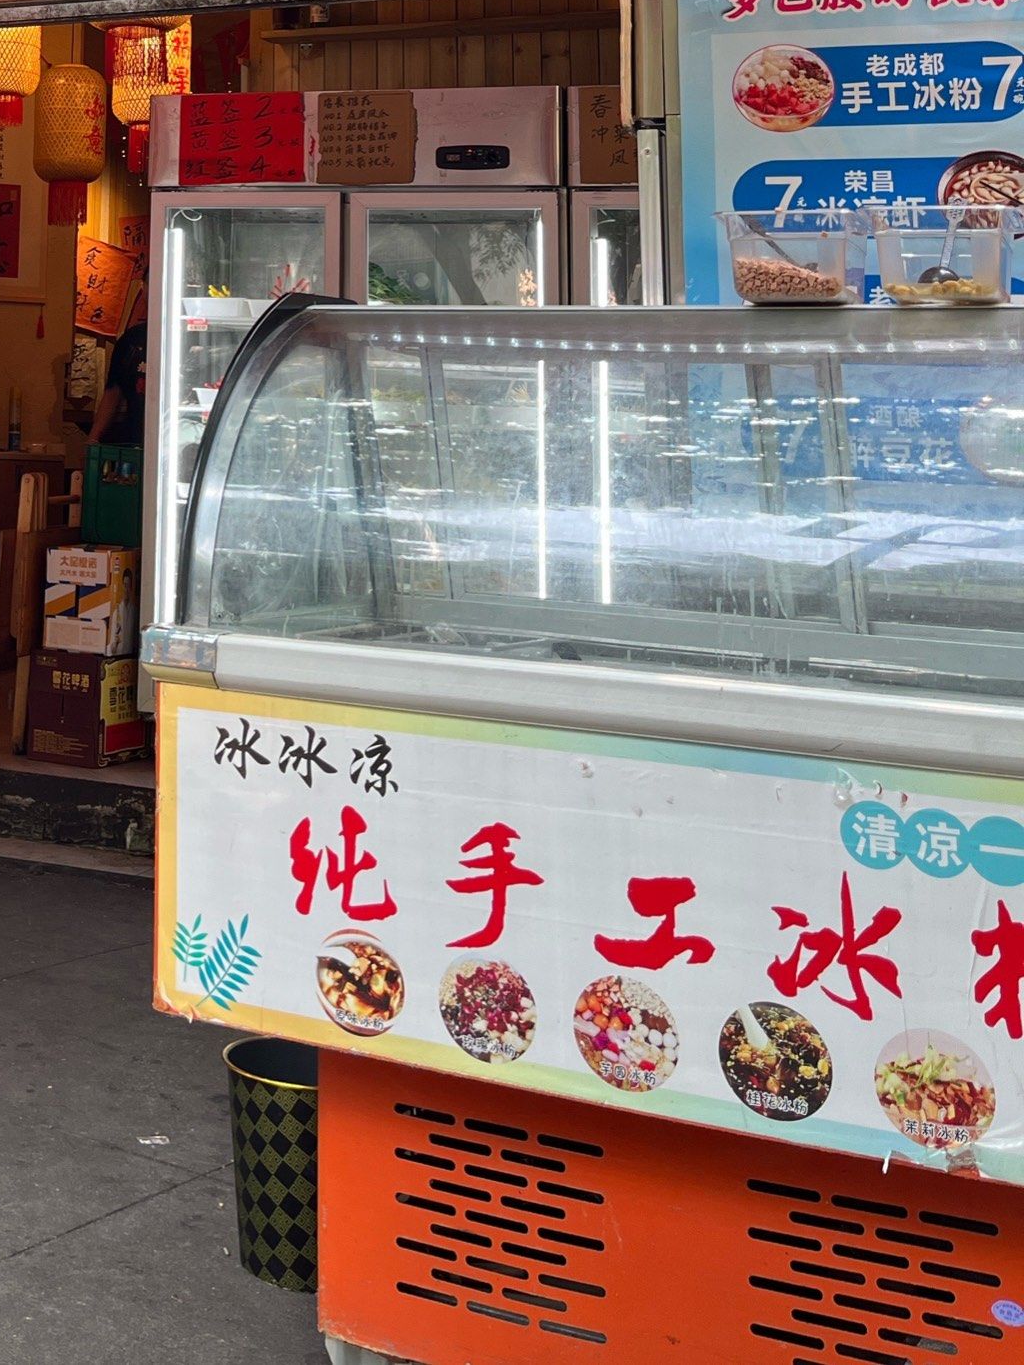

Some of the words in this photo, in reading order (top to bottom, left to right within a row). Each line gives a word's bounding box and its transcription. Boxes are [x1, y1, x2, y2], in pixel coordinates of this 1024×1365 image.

[866, 53, 944, 77] 老成都
[840, 77, 983, 114] 手工冰粉
[982, 55, 1023, 110] 7
[844, 170, 894, 193] 荣昌
[764, 176, 803, 228] 7
[213, 718, 400, 797] 冰冰凉
[334, 1008, 386, 1031] 原味冰粉
[745, 1090, 809, 1115] 桂花冰粉
[904, 1118, 970, 1144] 茉莉冰粉
